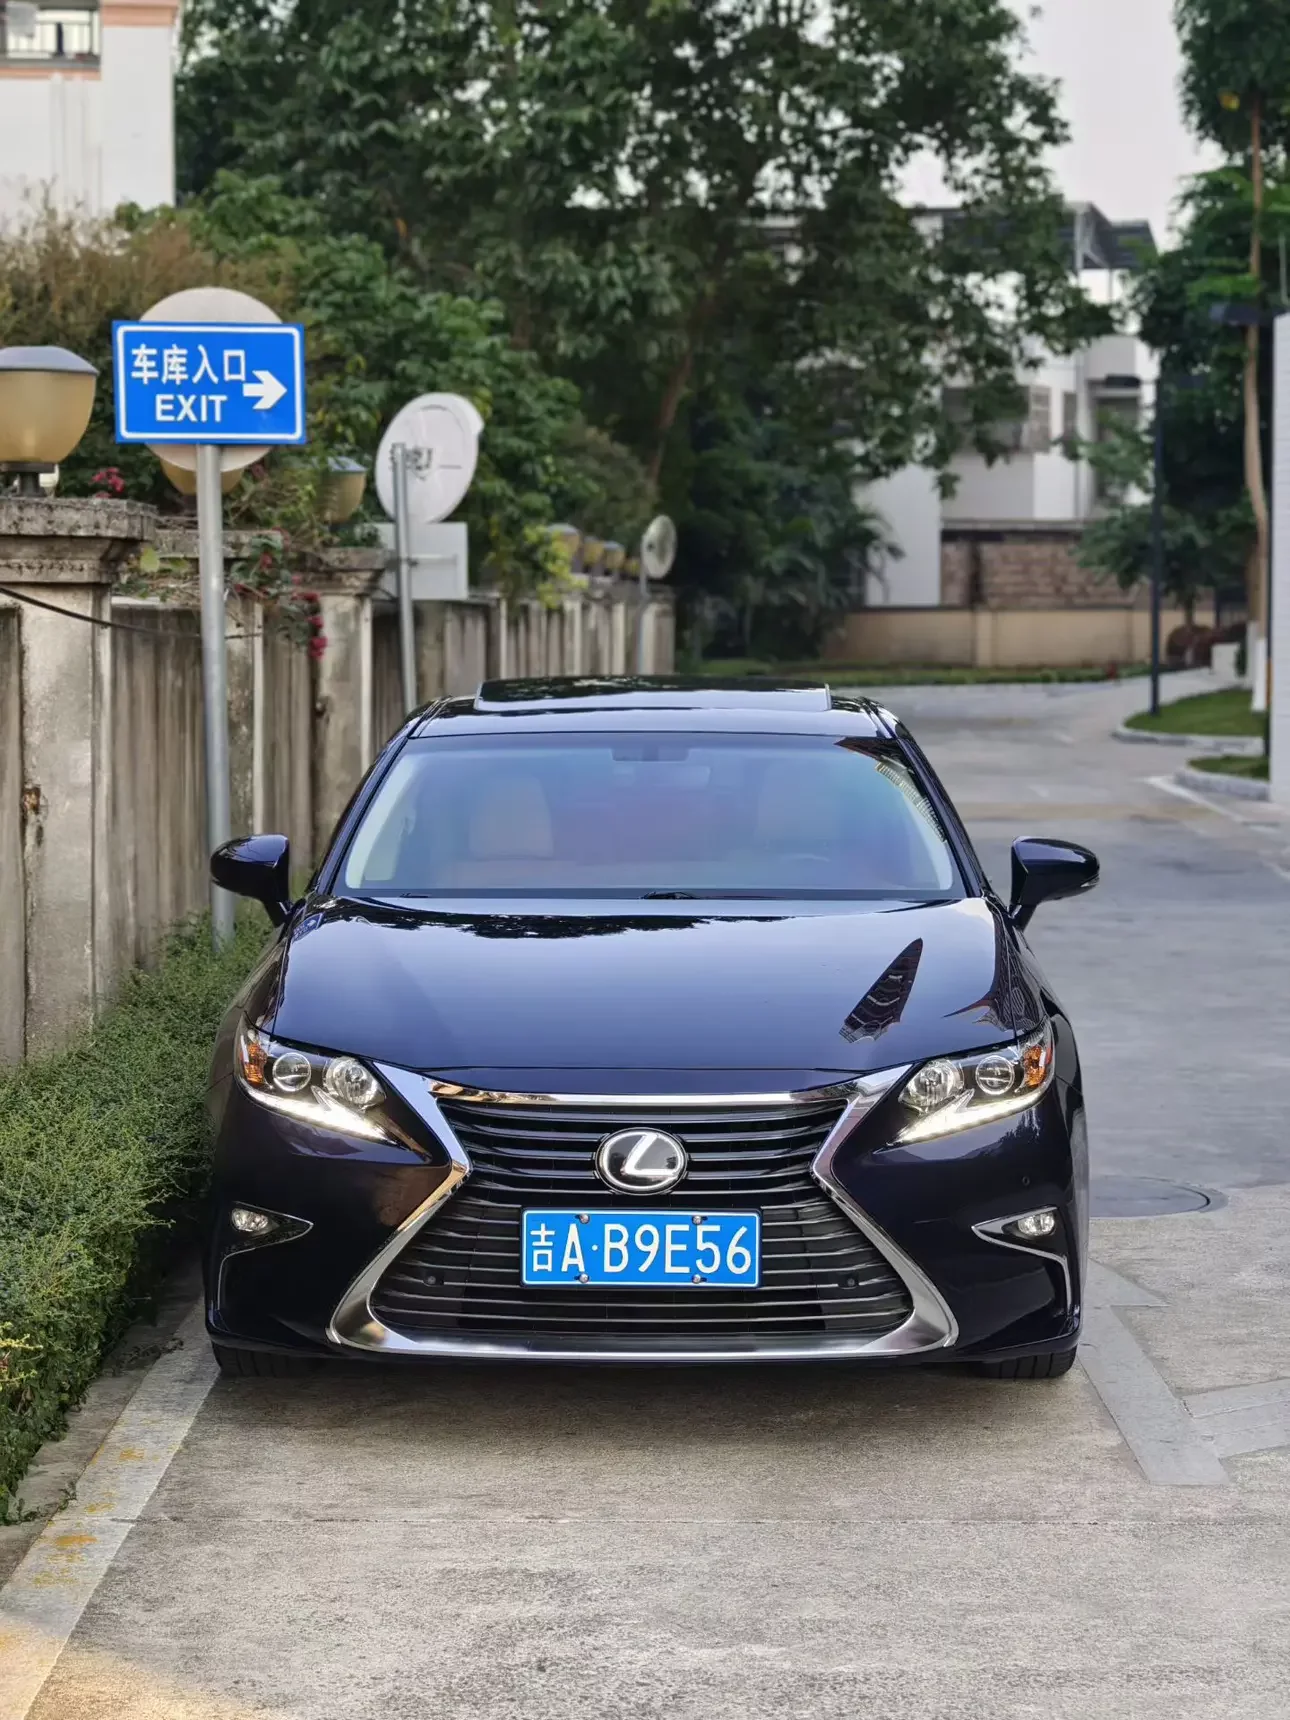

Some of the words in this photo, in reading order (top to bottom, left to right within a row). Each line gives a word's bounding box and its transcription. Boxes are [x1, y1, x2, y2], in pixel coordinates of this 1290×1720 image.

[131, 343, 246, 385] 车库入口
[155, 394, 228, 422] EXIT
[530, 1223, 751, 1275] 吉A·B9E56
